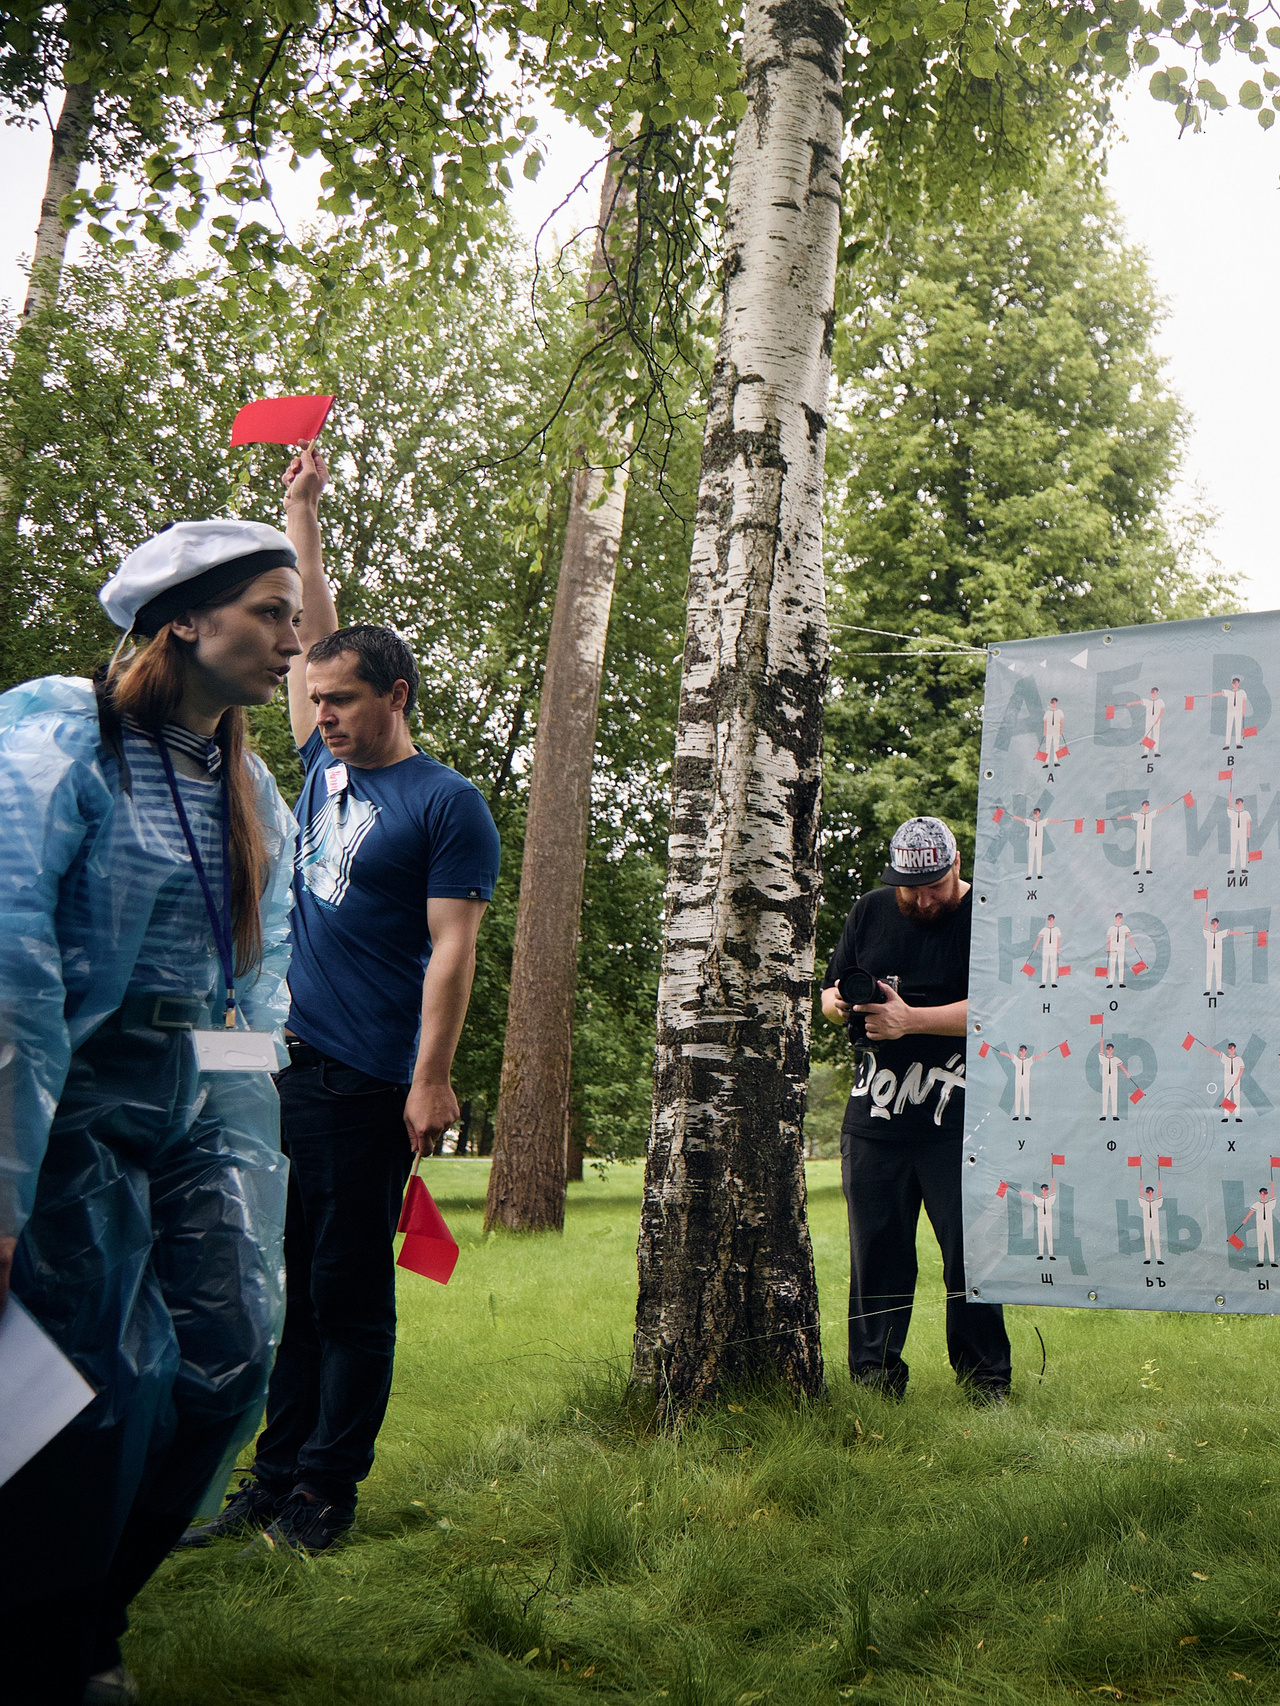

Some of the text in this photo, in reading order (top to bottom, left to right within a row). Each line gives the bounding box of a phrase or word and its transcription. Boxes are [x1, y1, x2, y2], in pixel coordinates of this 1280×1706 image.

[1227, 755, 1235, 767] В
[1146, 763, 1154, 774] Б
[1047, 773, 1055, 783] А
[895, 849, 937, 867] MARVEL
[1137, 882, 1145, 894] З
[1026, 890, 1038, 900] Ж
[1042, 1003, 1051, 1014] Н
[1109, 1000, 1119, 1012] О
[1208, 997, 1217, 1008] П
[1018, 1139, 1026, 1151] У
[1106, 1140, 1117, 1152] Ф
[1227, 1140, 1236, 1152] Х
[1041, 1273, 1054, 1287] Щ
[1257, 1279, 1270, 1291] Ы
